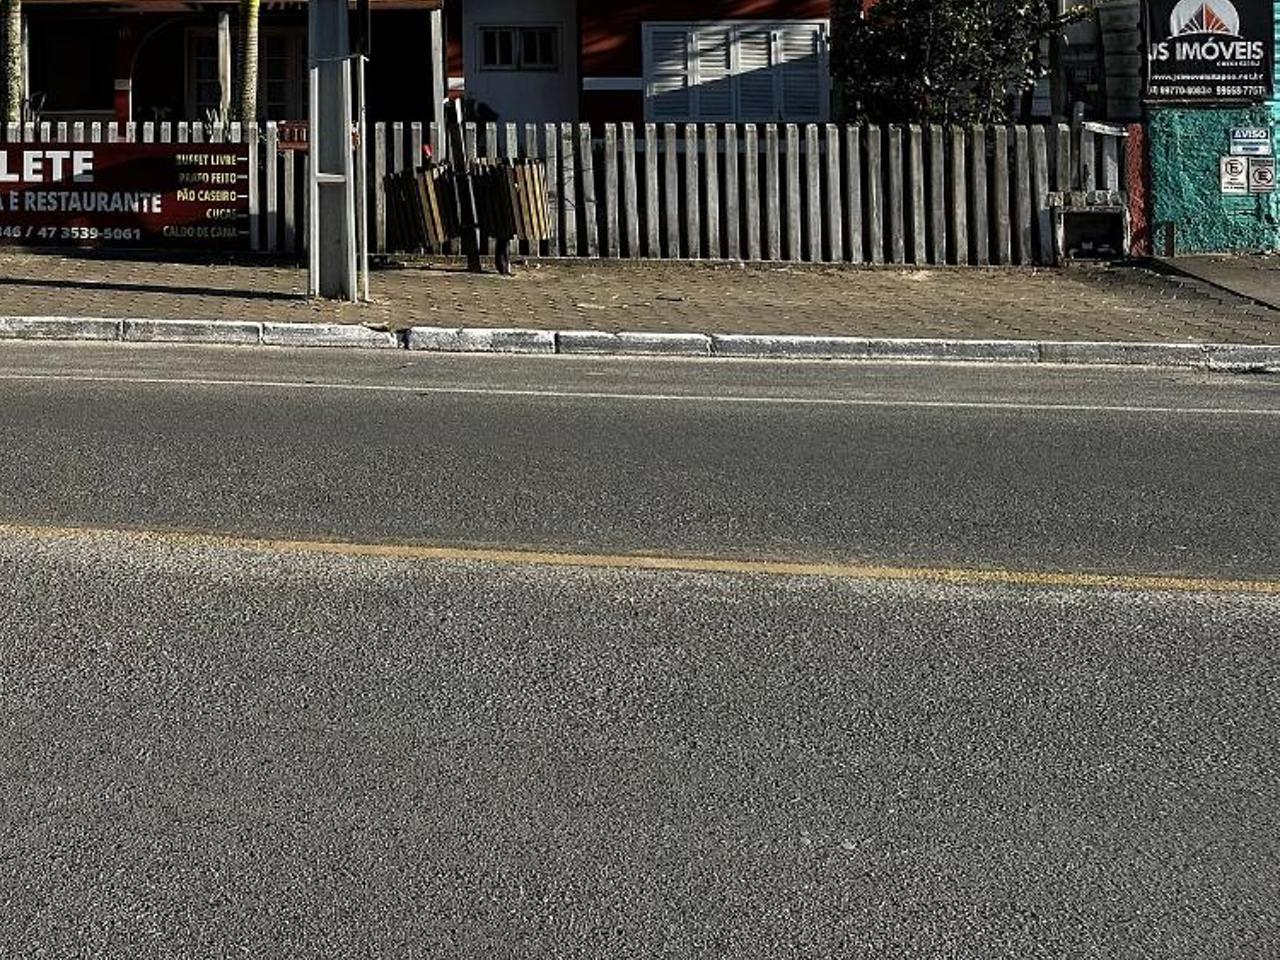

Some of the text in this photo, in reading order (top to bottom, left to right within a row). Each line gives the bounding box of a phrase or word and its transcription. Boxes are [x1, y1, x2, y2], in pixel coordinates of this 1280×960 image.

[1176, 37, 1264, 60] IMÓVEIS
[1233, 129, 1267, 138] AVISO
[211, 154, 237, 166] LIVRE
[211, 173, 237, 184] FEITO
[176, 188, 237, 202] PÃO CASEIRO
[9, 190, 19, 211] E
[24, 190, 162, 213] RESTAURANTE
[37, 226, 57, 238] 47
